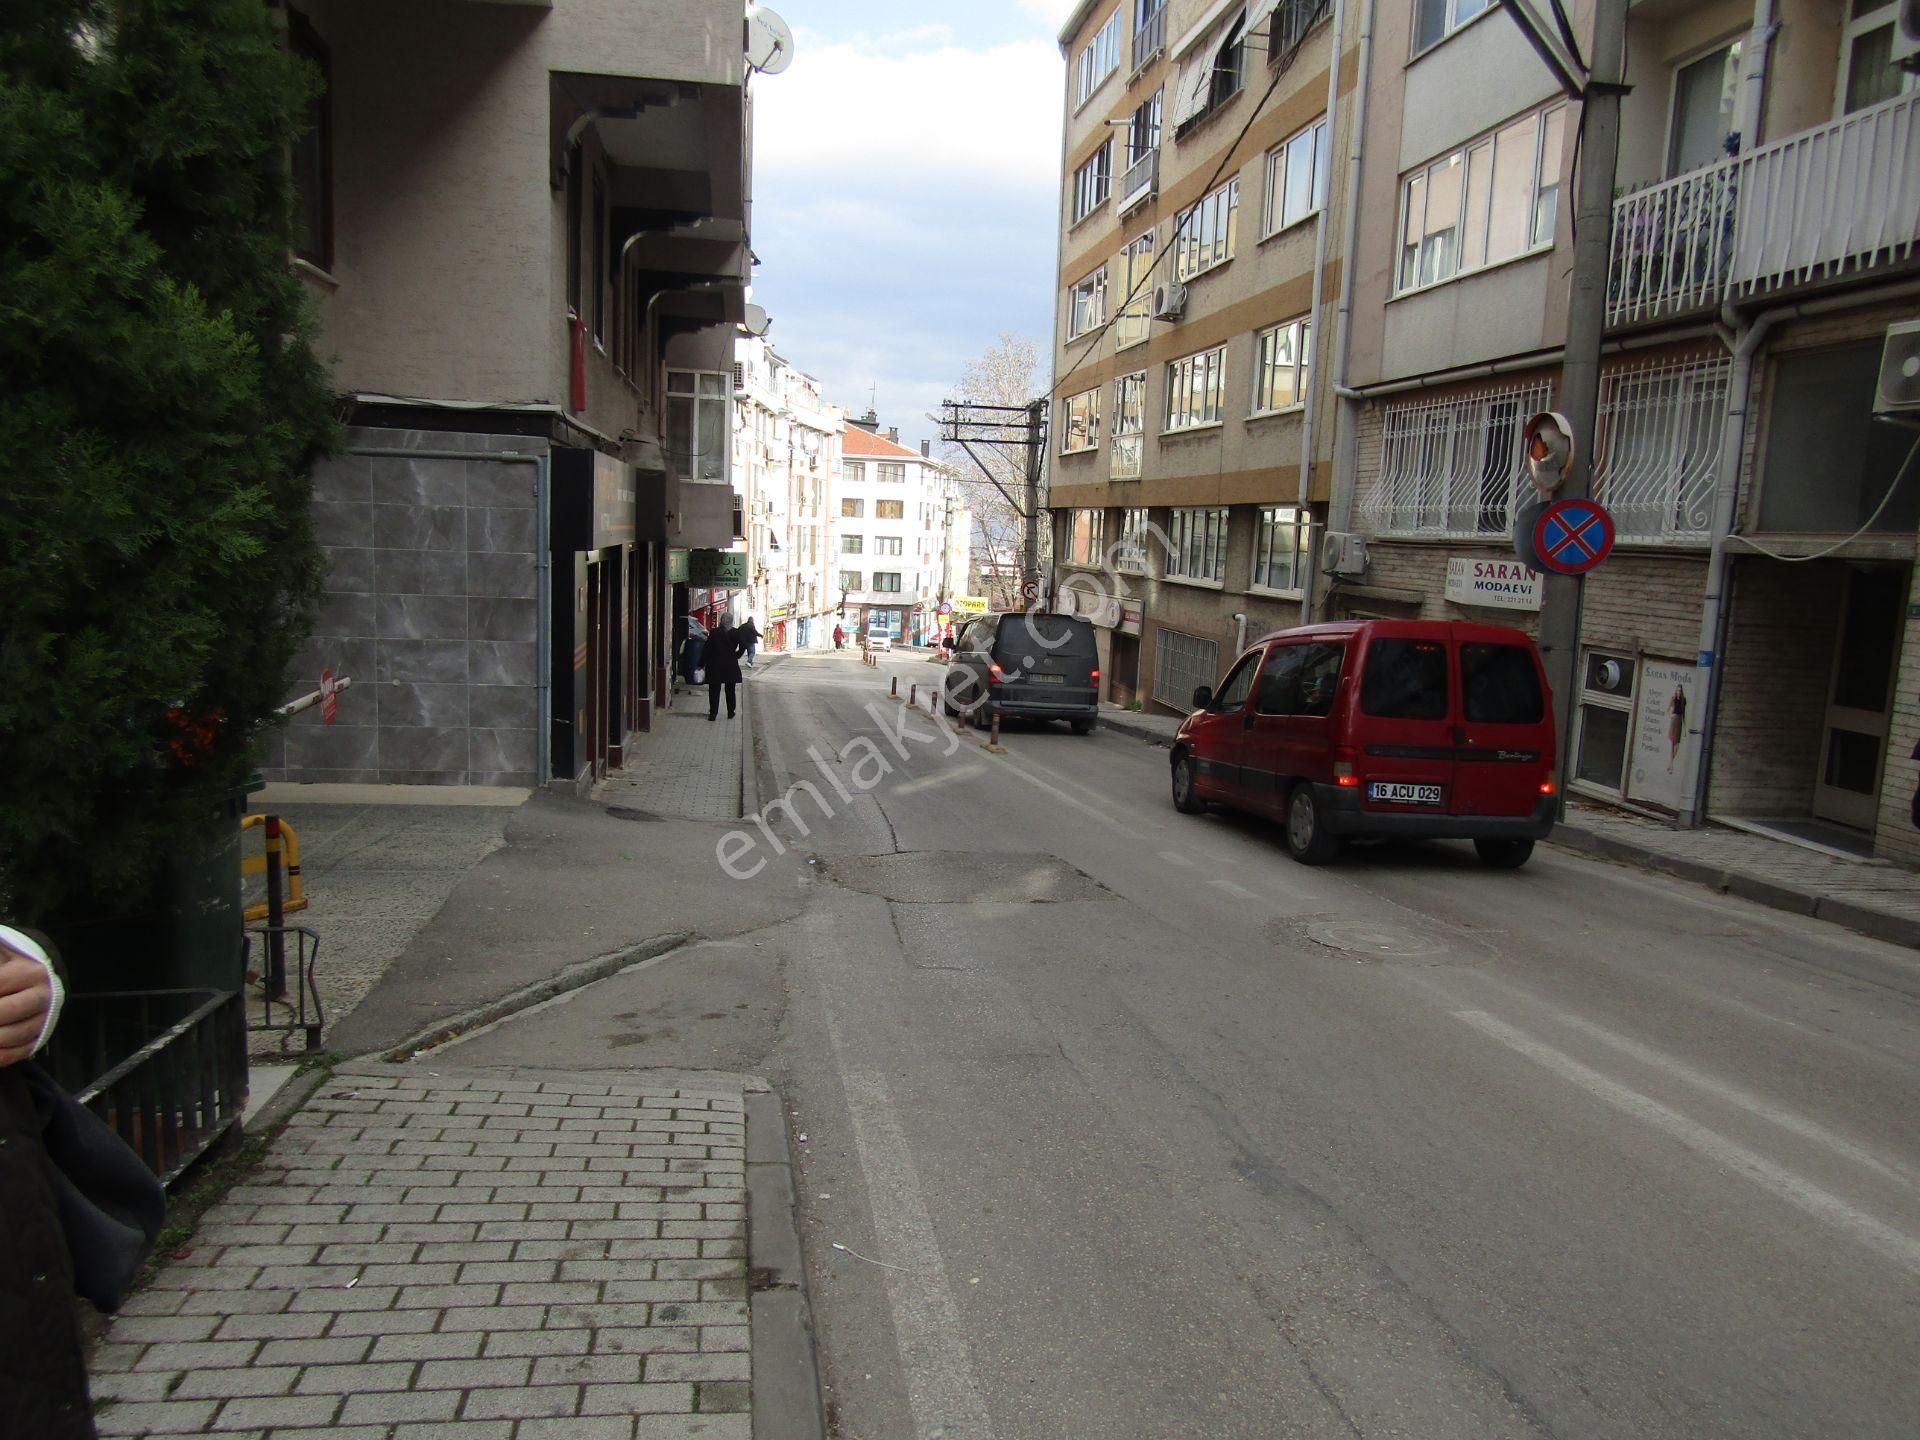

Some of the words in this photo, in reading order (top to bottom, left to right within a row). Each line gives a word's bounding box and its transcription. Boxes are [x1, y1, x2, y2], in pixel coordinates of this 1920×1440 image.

[1474, 562, 1537, 582] SARAN
[955, 599, 986, 609] OTOPARK
[1375, 784, 1388, 797] 16
[1391, 785, 1415, 799] ACU
[1418, 787, 1440, 800] 029
